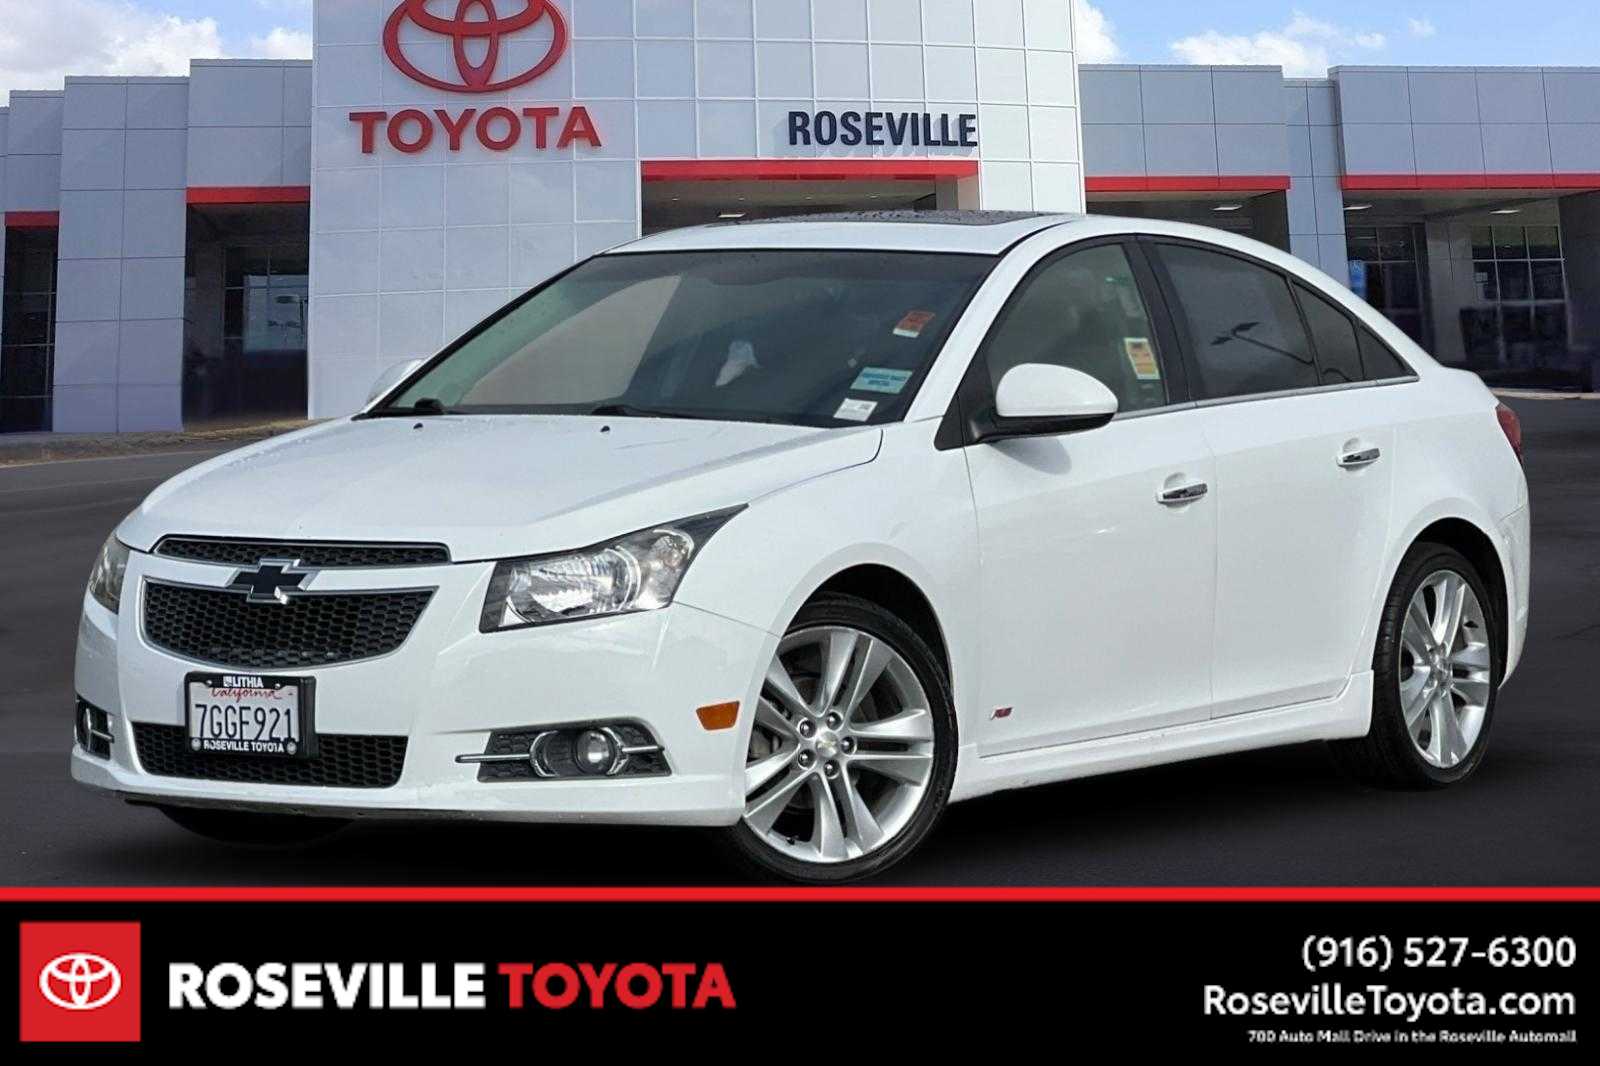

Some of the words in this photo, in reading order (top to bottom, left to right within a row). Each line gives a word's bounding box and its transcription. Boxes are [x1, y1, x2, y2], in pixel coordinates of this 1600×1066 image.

[350, 106, 602, 153] TOYOTA
[788, 111, 978, 147] ROSEVILLE
[232, 676, 264, 688] LITHIA
[195, 704, 292, 741] 7GGF921
[203, 740, 250, 752] ROSEVILLE
[251, 741, 285, 753] TOYOTA
